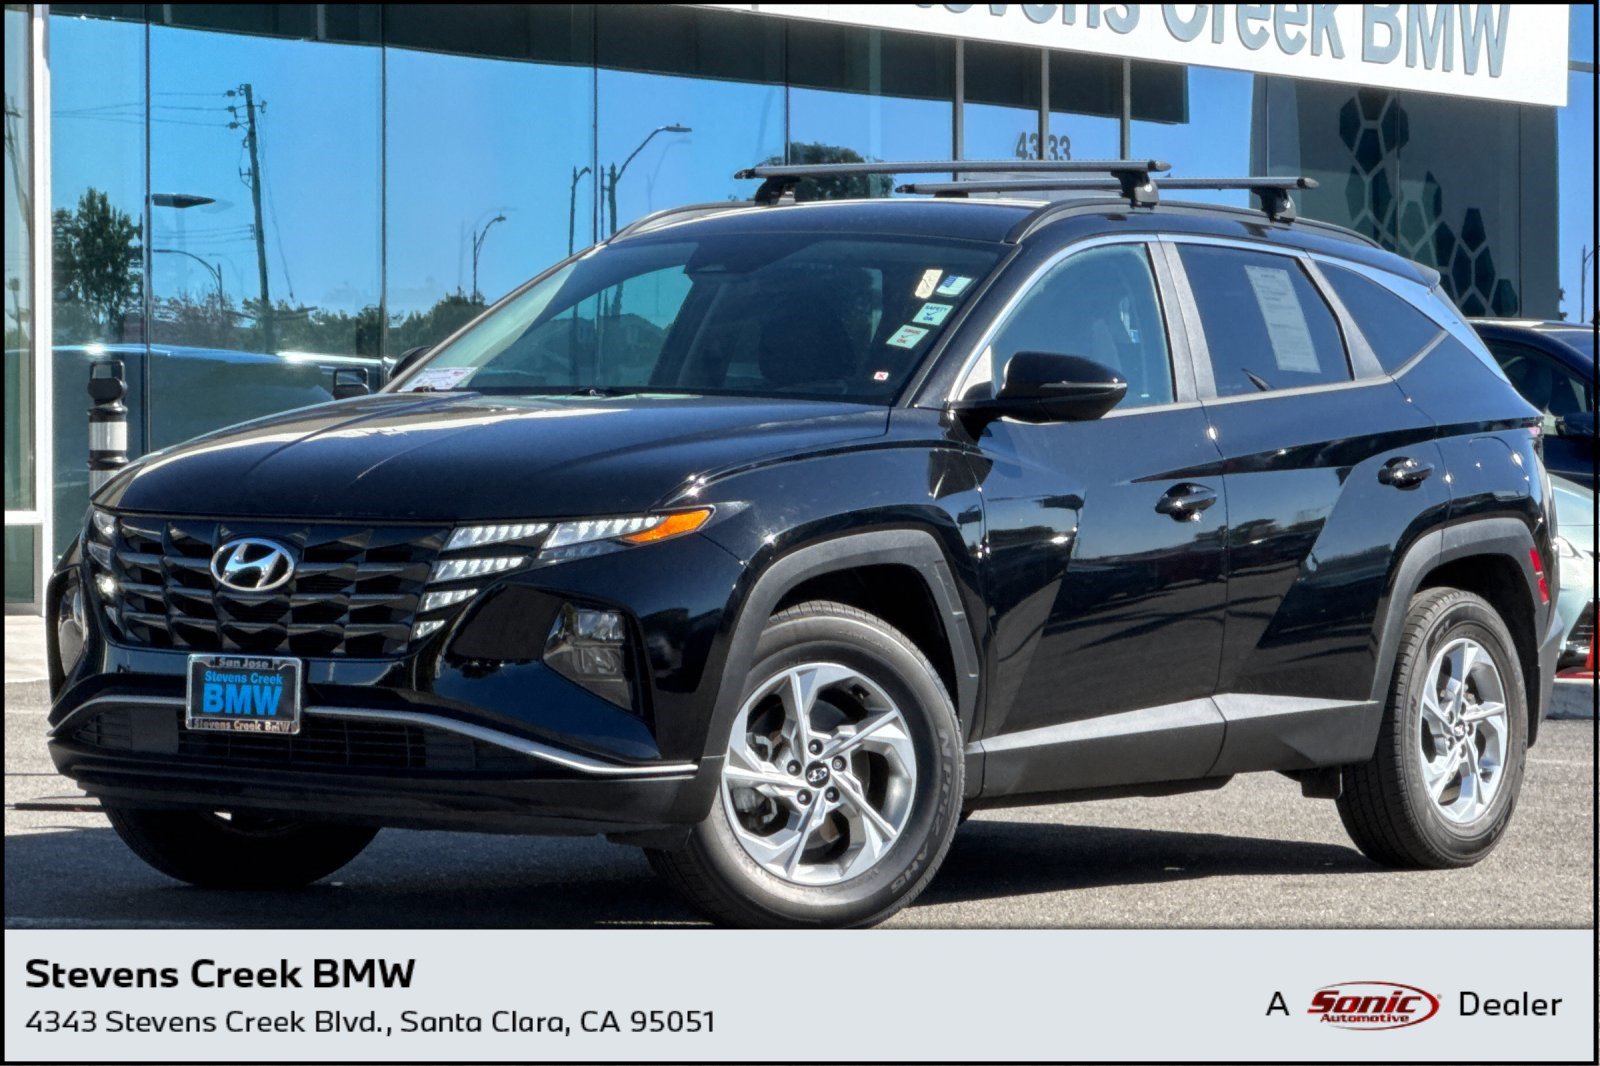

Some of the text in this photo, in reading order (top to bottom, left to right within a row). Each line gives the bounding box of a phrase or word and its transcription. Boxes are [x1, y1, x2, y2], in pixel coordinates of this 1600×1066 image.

[1361, 4, 1511, 78] BMW
[219, 658, 269, 669] San Jose
[204, 671, 283, 685] Stevens Creek
[203, 683, 283, 715] BMW
[194, 718, 231, 729] Stevens
[233, 719, 261, 731] Creek
